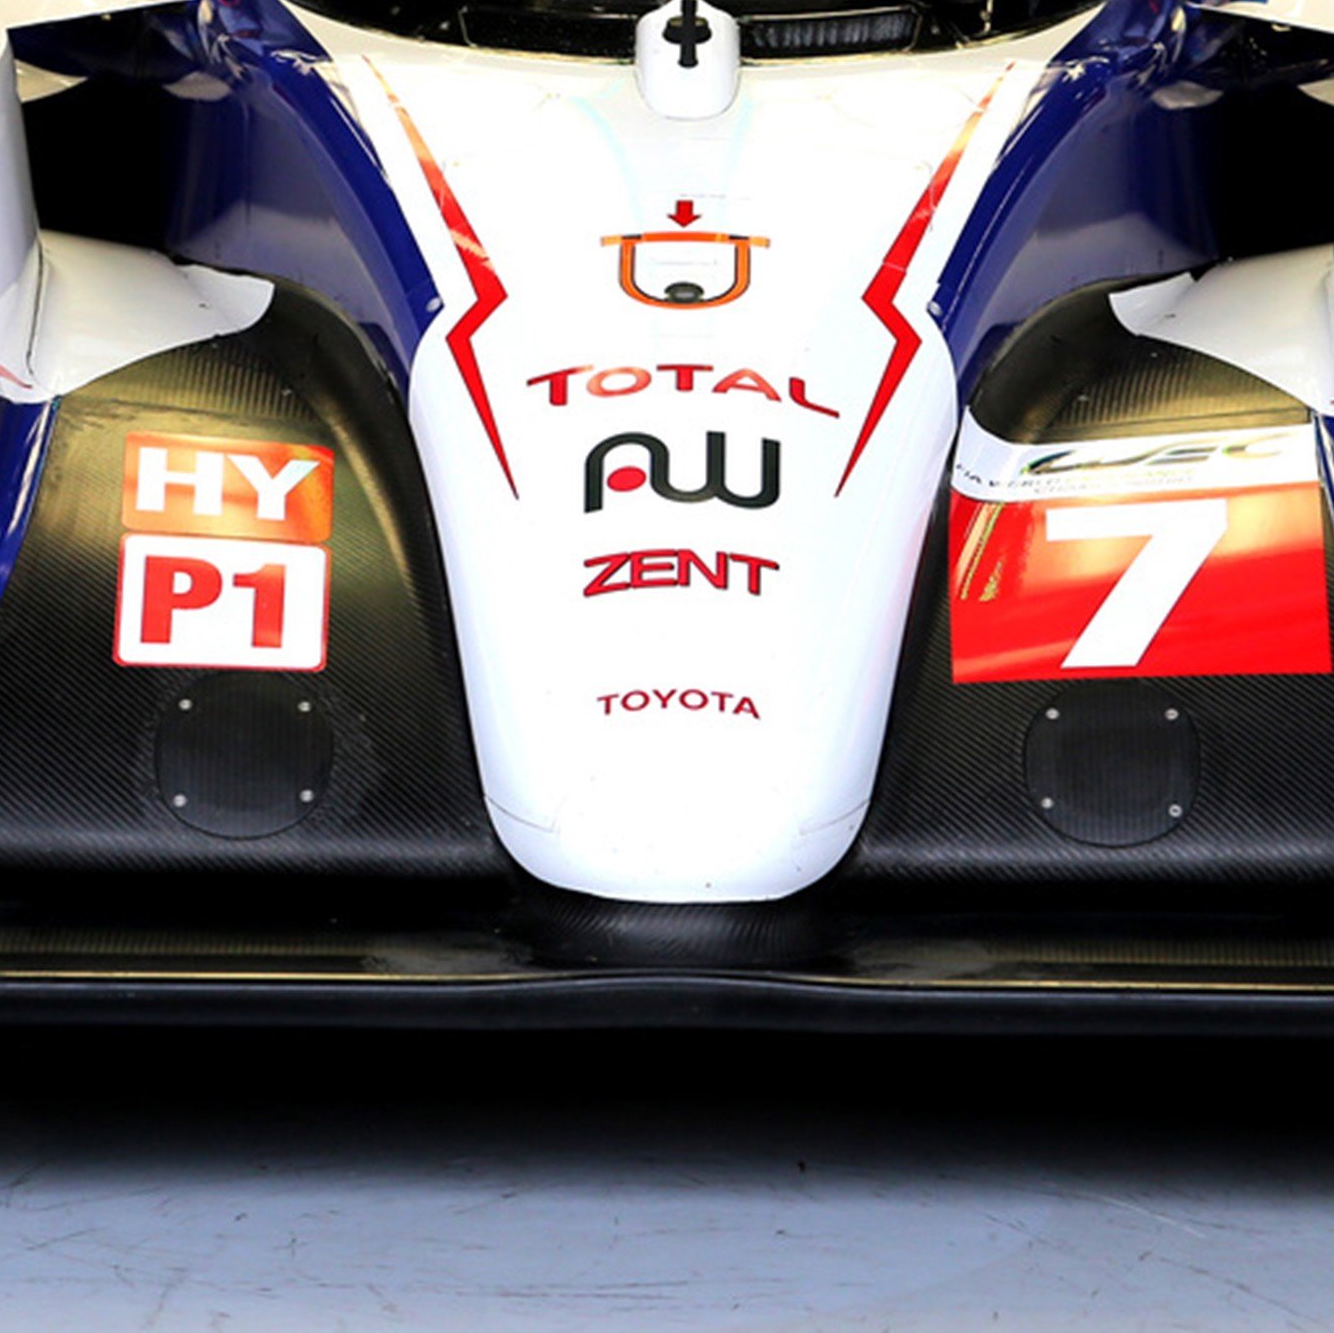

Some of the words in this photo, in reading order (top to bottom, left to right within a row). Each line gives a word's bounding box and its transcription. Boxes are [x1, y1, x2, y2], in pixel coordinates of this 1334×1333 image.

[526, 363, 840, 419] TOTAL
[136, 445, 322, 521] HY
[140, 554, 287, 649] P1
[583, 548, 780, 598] ZENT
[1044, 498, 1229, 670] 7
[596, 688, 761, 720] TOYOTA
